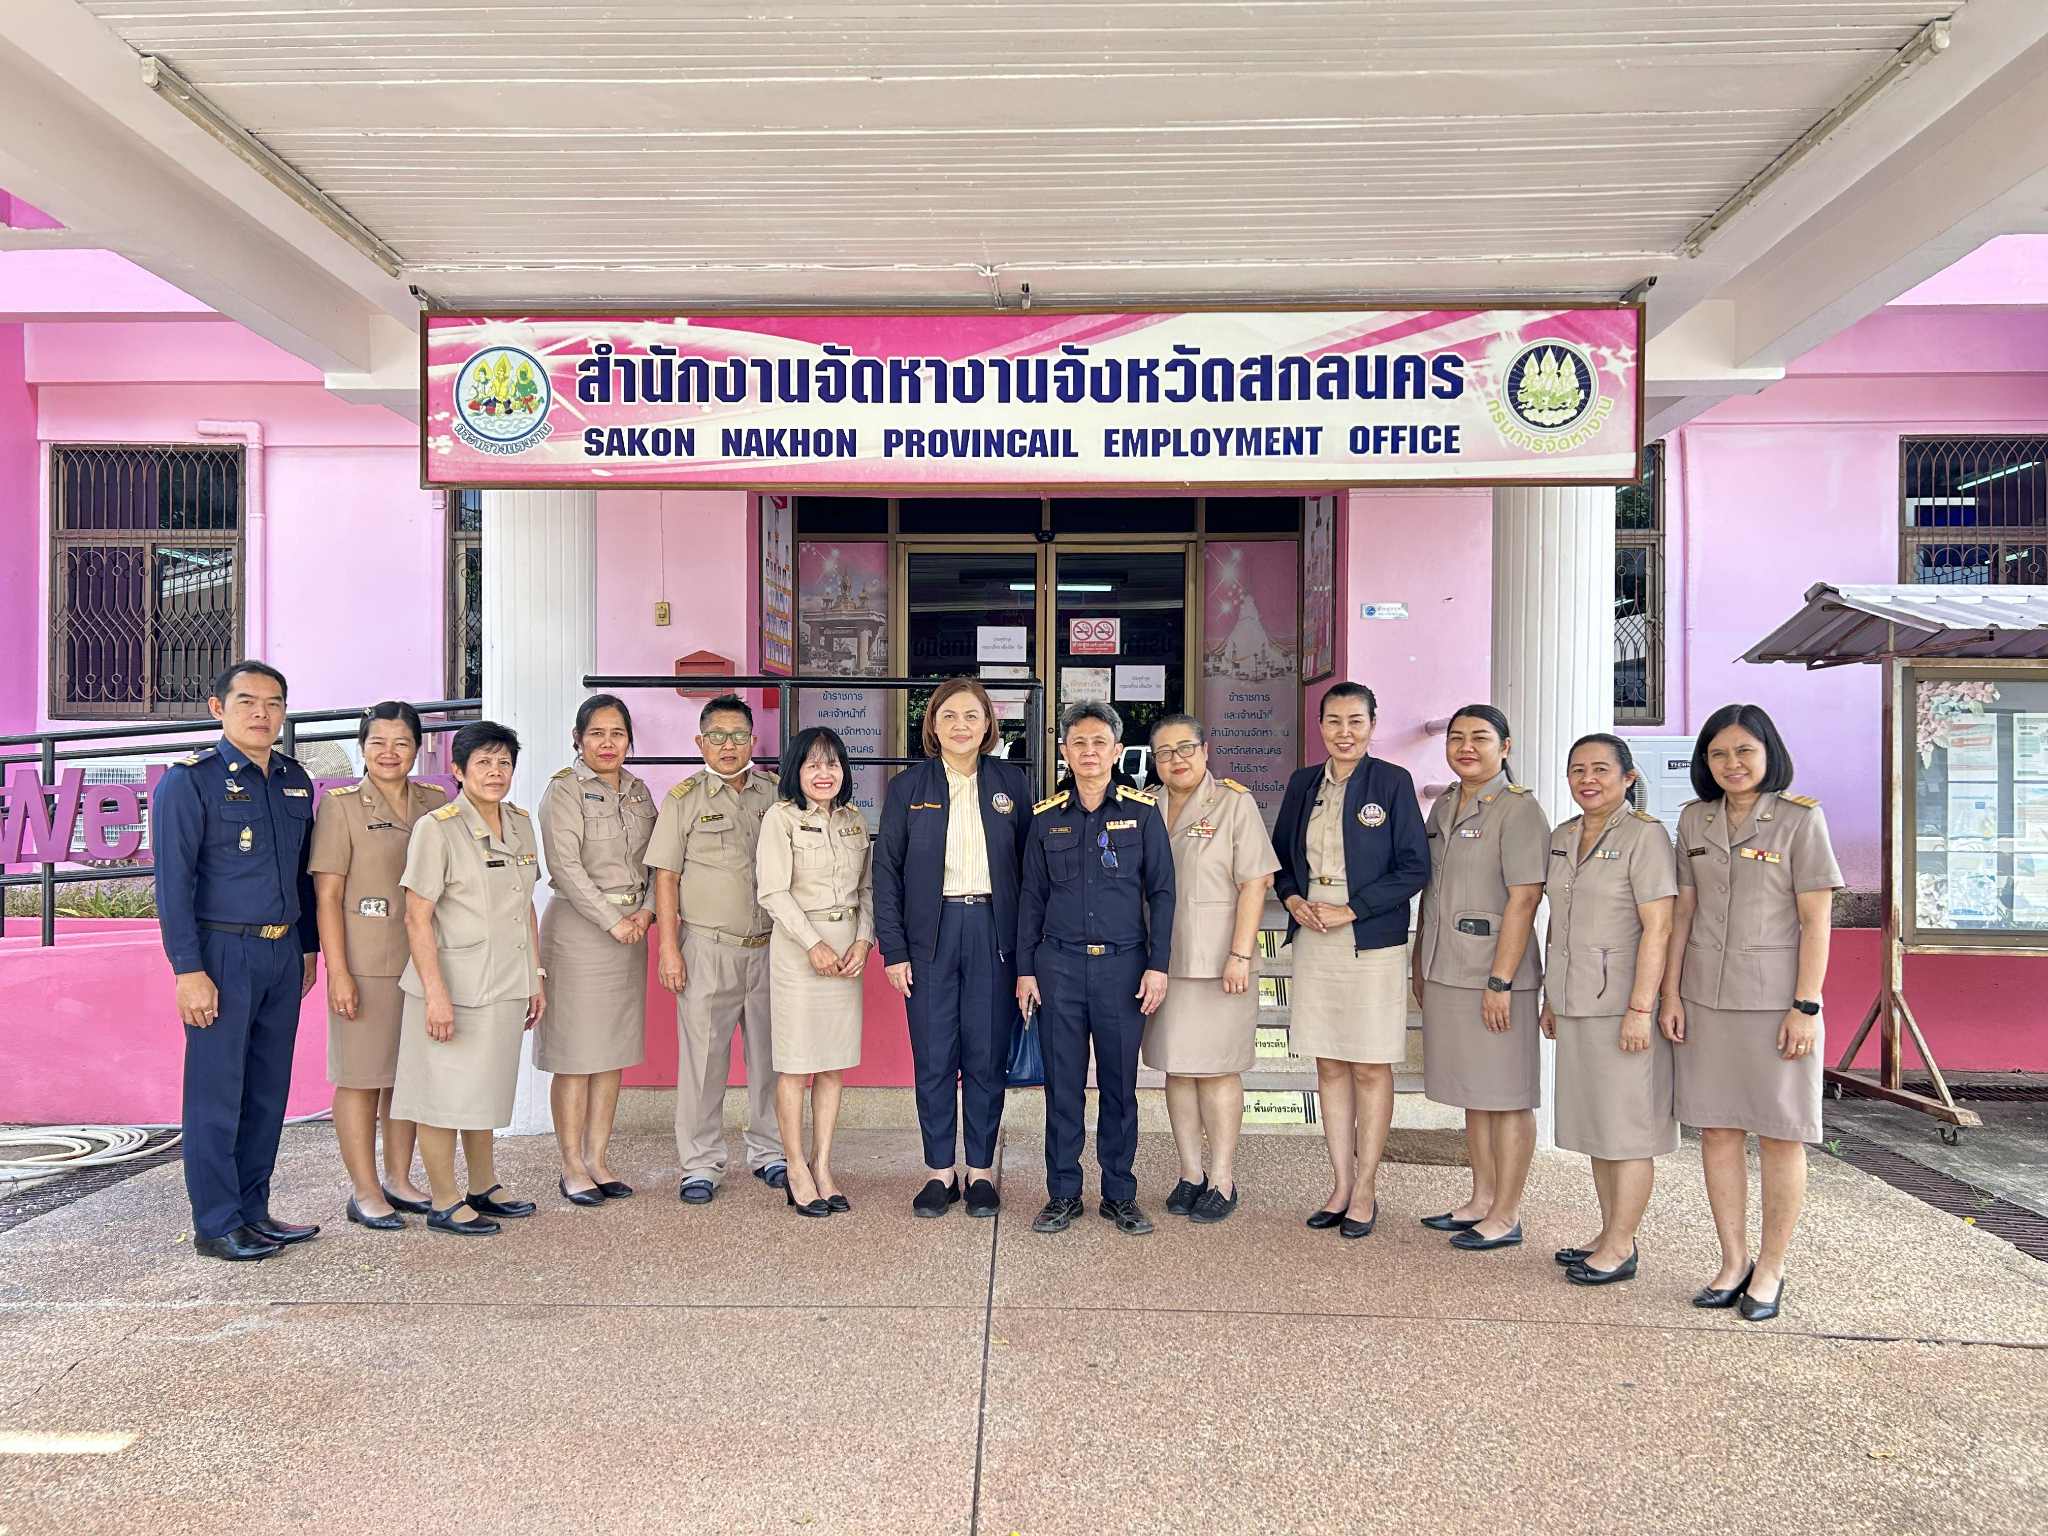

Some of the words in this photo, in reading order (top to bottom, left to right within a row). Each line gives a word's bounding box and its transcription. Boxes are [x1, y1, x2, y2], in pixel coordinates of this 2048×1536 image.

[578, 343, 1464, 403] สำนักงานจัดหางานจังหวัดสกลนคร
[584, 427, 695, 457] SAKON
[721, 428, 857, 458] NAKHON
[884, 429, 1079, 458] PROVINCAIL
[1104, 426, 1323, 458] EMPLOYMENT
[1350, 425, 1460, 455] OFFICE
